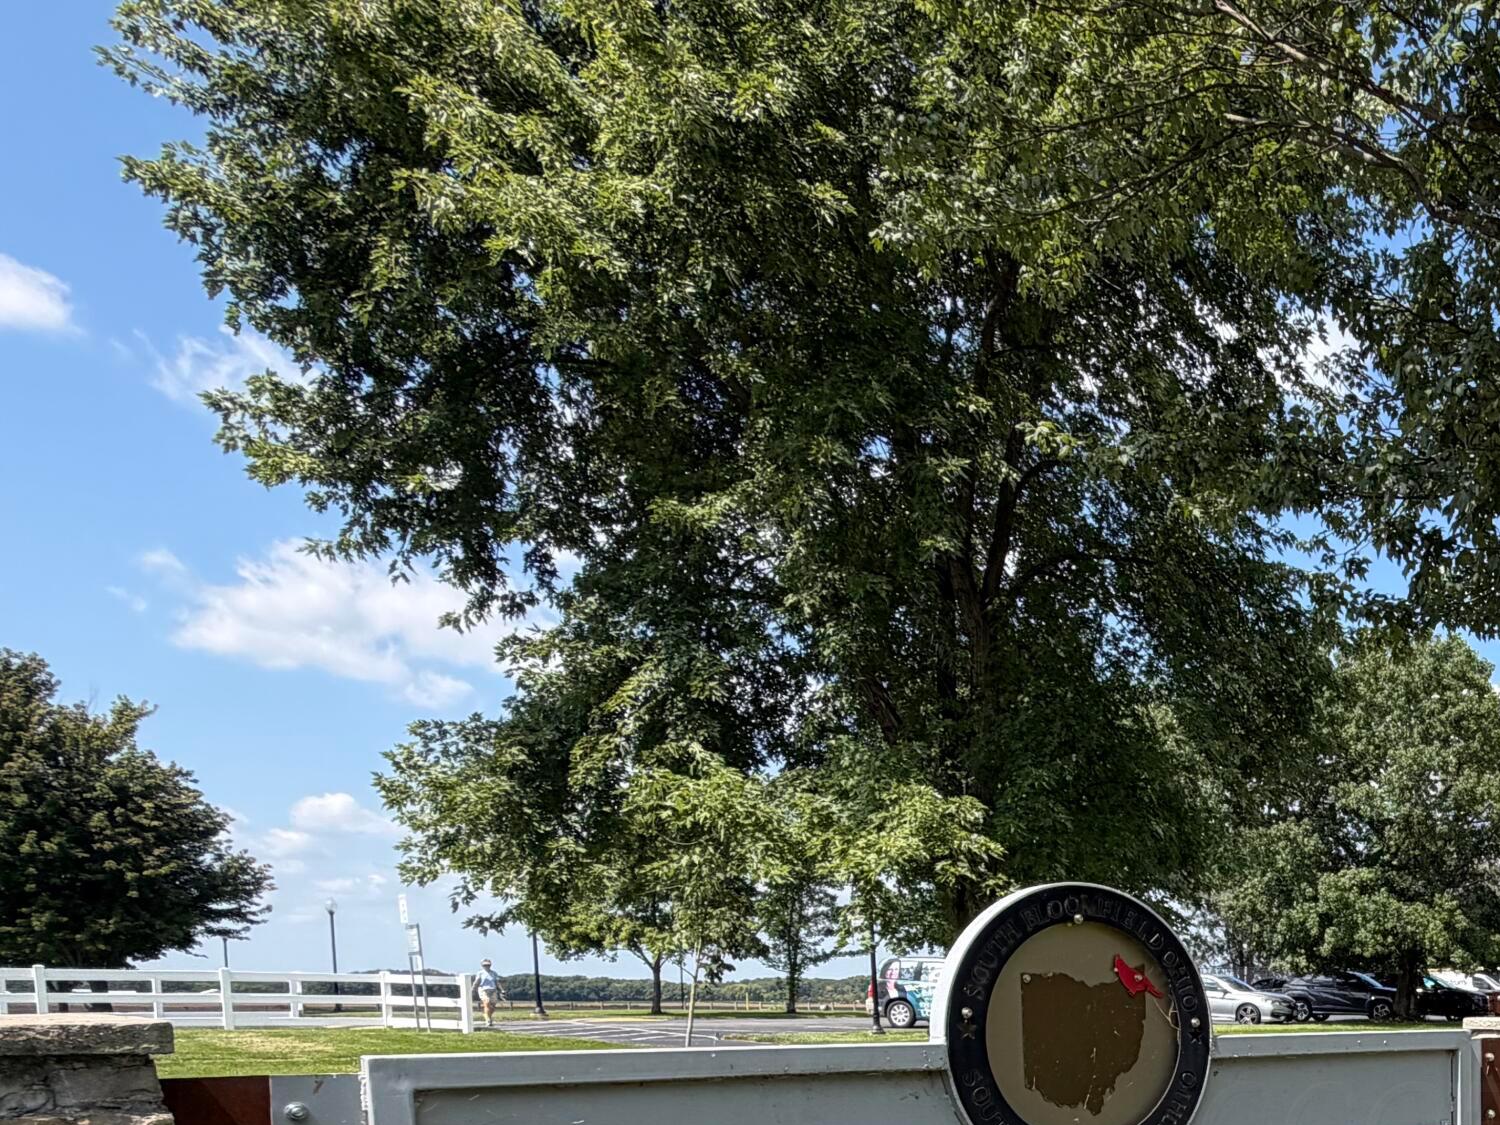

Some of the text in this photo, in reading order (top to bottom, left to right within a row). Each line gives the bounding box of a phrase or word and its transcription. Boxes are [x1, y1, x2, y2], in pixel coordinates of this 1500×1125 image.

[963, 893, 1199, 1013] SOUTH BLOOMFIELD OHIO
